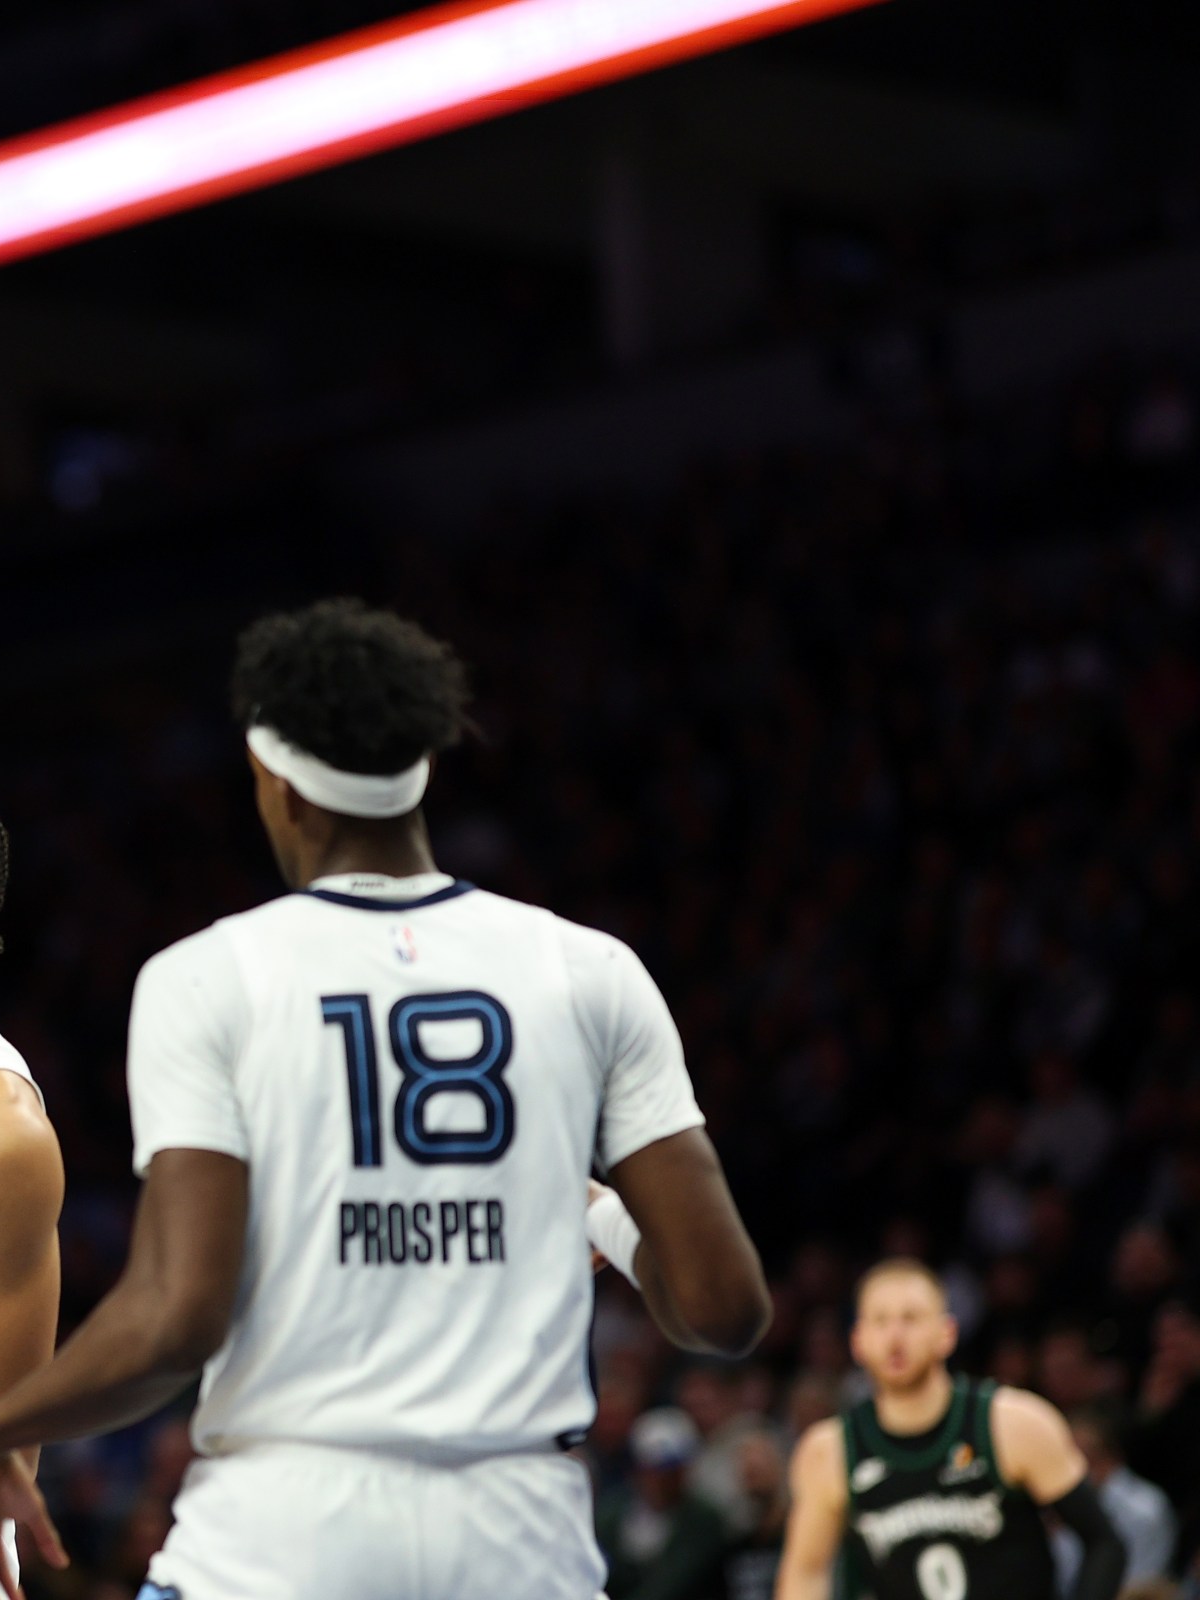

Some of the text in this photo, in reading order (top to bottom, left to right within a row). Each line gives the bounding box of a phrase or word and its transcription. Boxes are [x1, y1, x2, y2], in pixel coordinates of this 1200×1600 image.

[320, 990, 516, 1168] 18
[338, 1200, 506, 1265] PROSPER
[915, 1542, 968, 1600] 0
